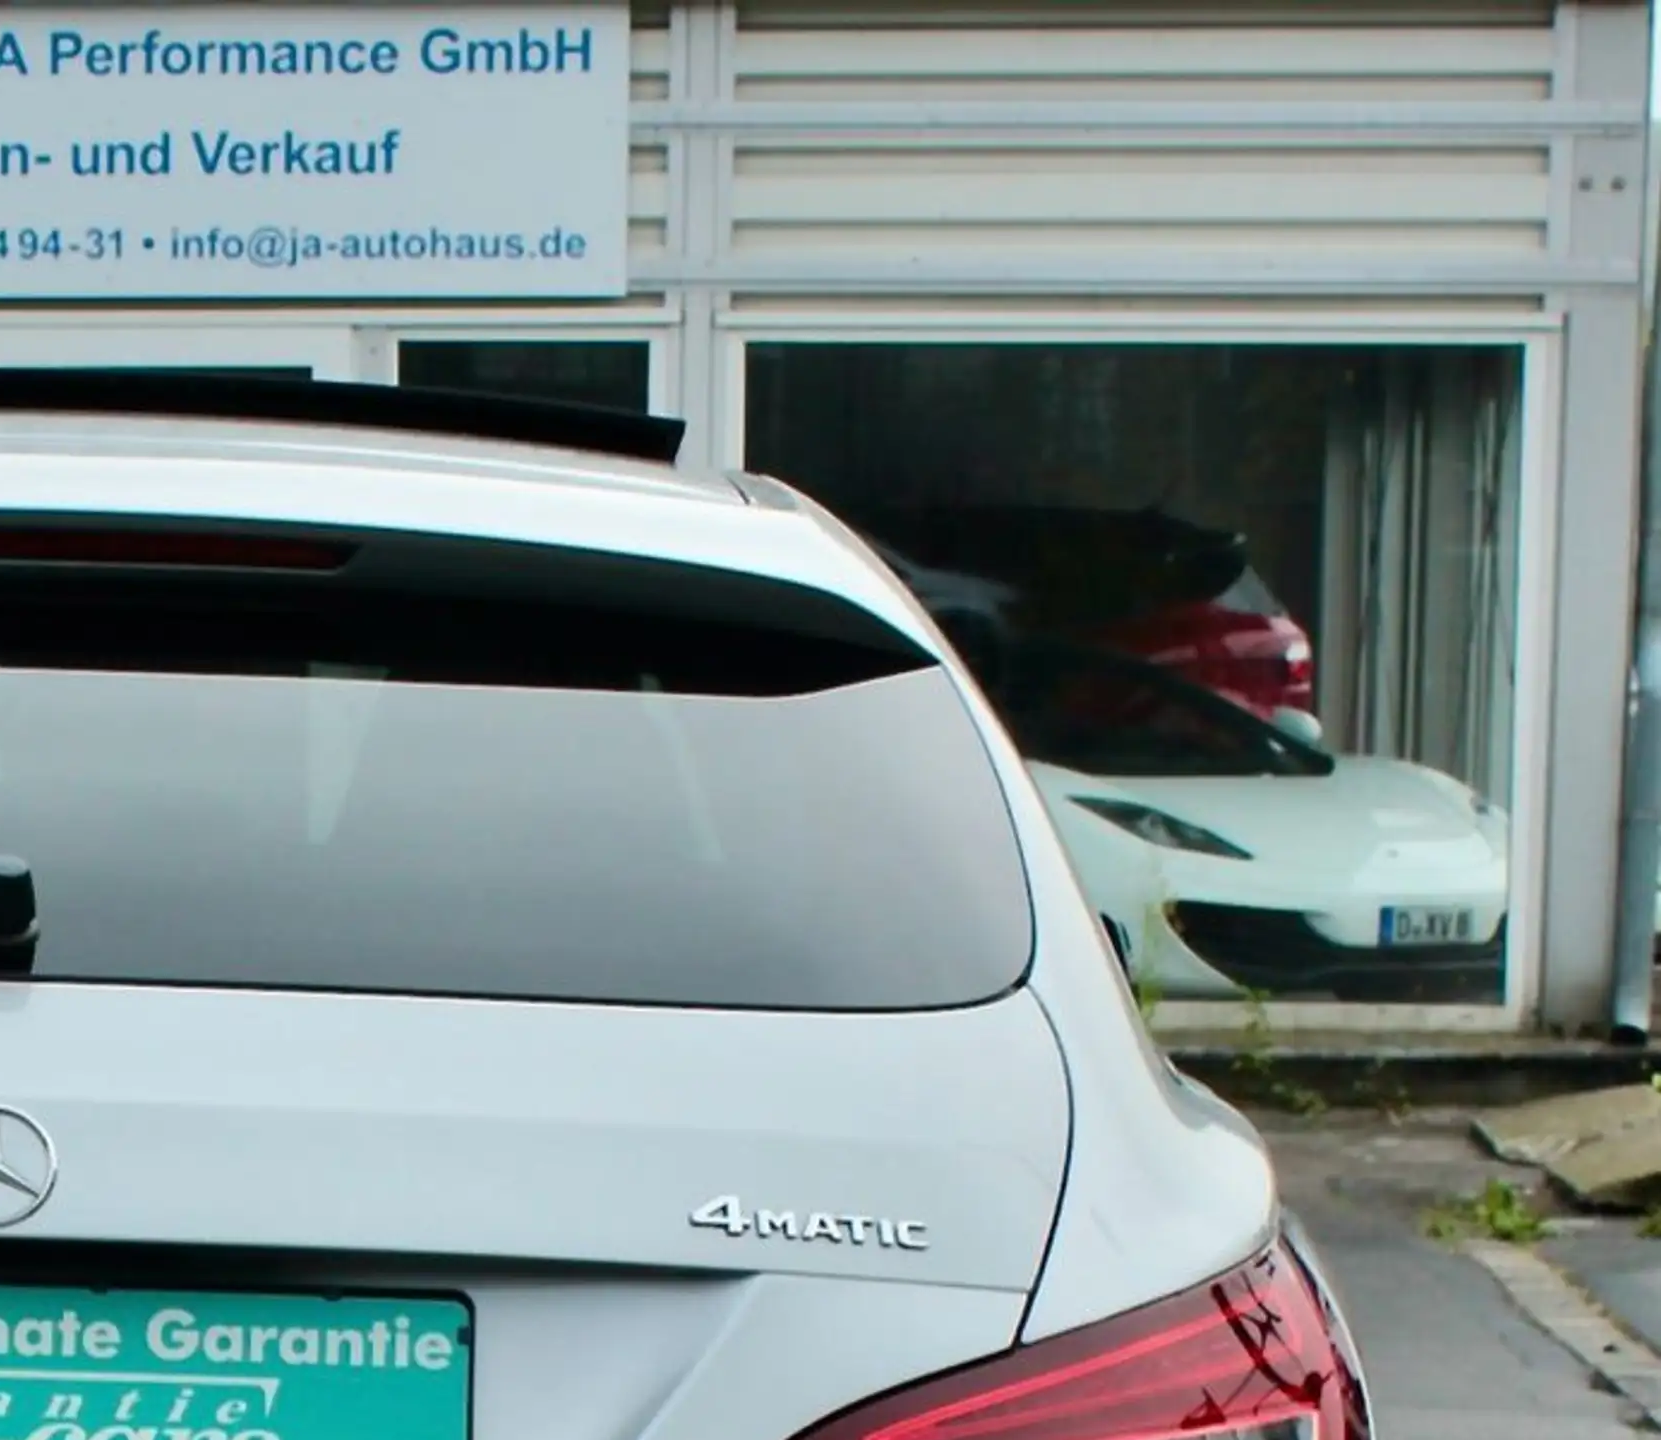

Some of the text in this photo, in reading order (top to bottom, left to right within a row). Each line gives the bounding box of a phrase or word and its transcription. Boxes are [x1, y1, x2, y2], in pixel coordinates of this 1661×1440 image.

[49, 29, 400, 76] Performance
[419, 27, 593, 74] GmbH
[71, 130, 172, 176] und
[191, 129, 401, 175] Verkauf
[170, 225, 587, 268] info@ja-autohaus.de
[688, 1194, 931, 1252] 4MATIC
[145, 1308, 454, 1370] Garantie
